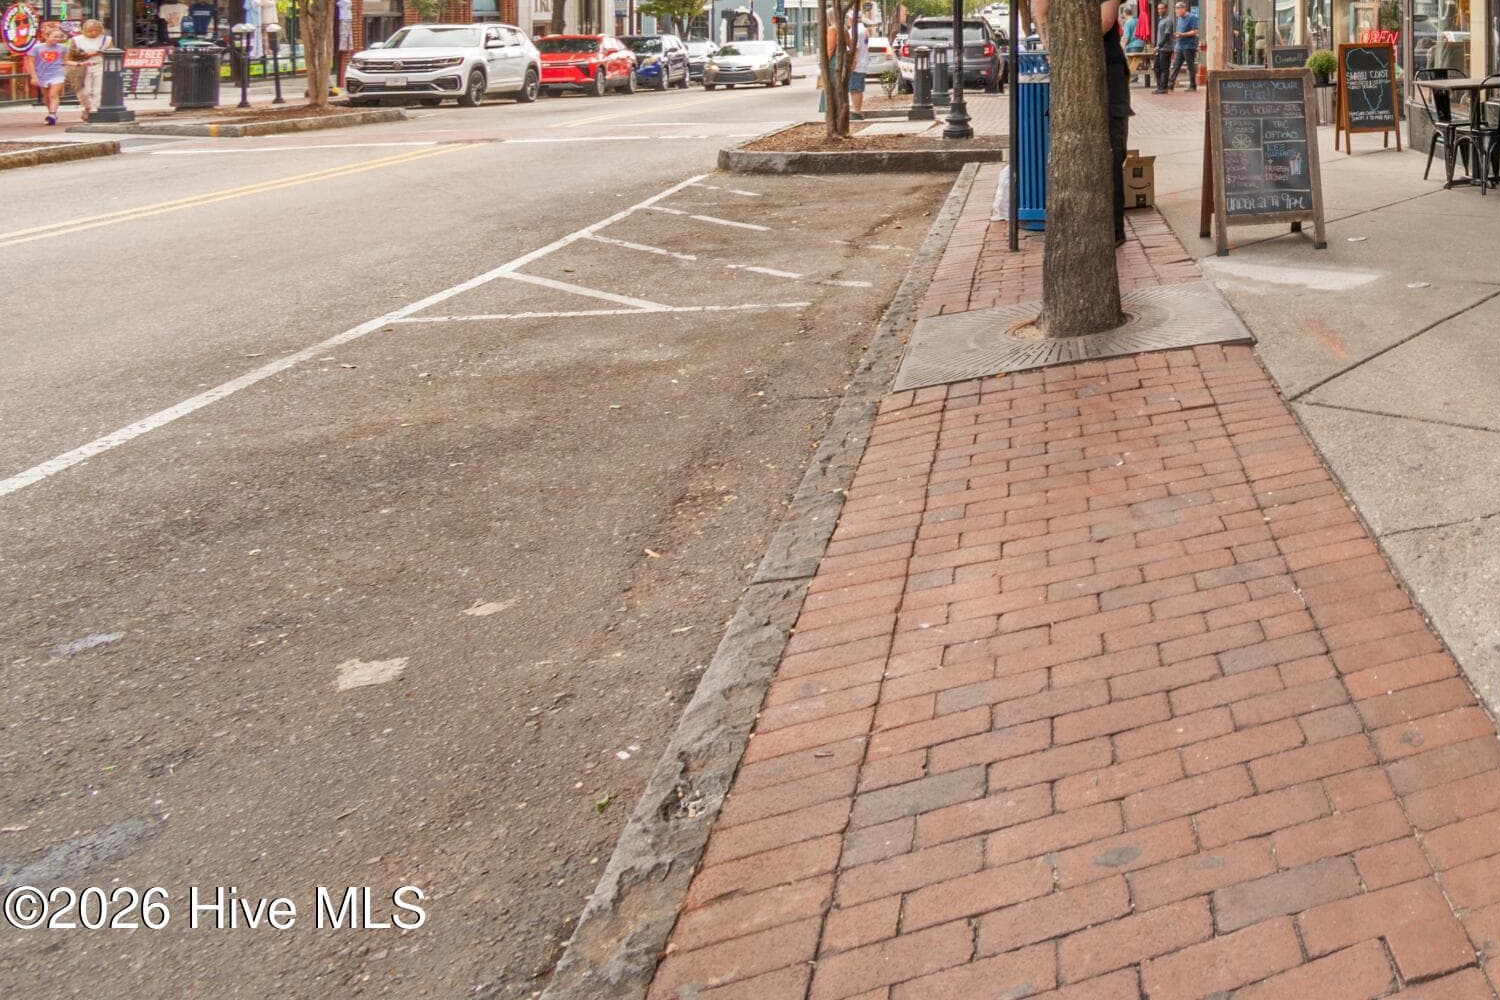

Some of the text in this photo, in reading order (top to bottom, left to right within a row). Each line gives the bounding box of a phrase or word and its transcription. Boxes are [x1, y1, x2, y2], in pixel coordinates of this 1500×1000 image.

[1360, 31, 1398, 45] OPEN
[140, 48, 164, 59] FREE
[1370, 69, 1388, 79] COAST
